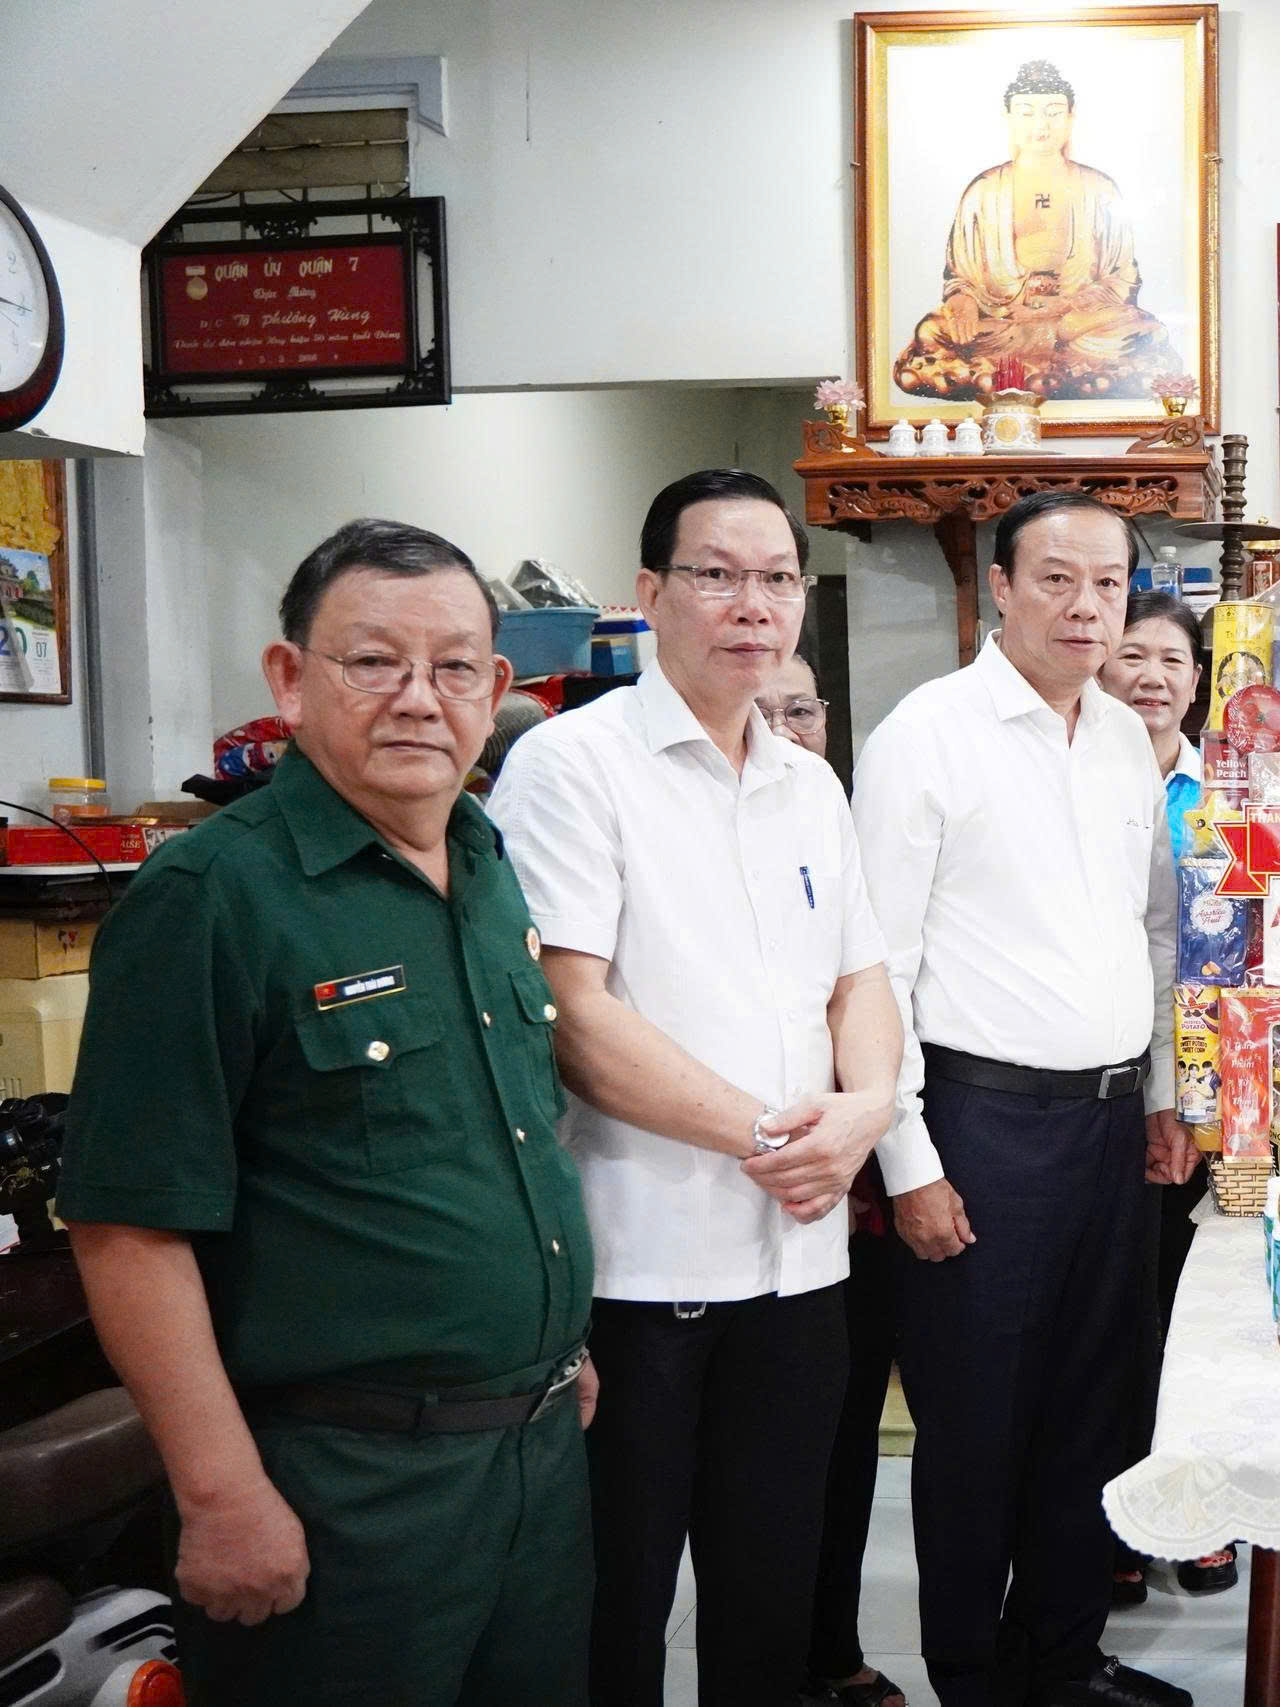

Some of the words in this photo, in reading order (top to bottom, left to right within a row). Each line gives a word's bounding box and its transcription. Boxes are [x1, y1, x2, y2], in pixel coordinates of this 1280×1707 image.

[214, 260, 249, 282] QUẬN
[299, 256, 333, 278] QUẬN
[349, 256, 359, 272] 7
[1216, 759, 1248, 769] Yellow
[1216, 769, 1247, 778] Peach
